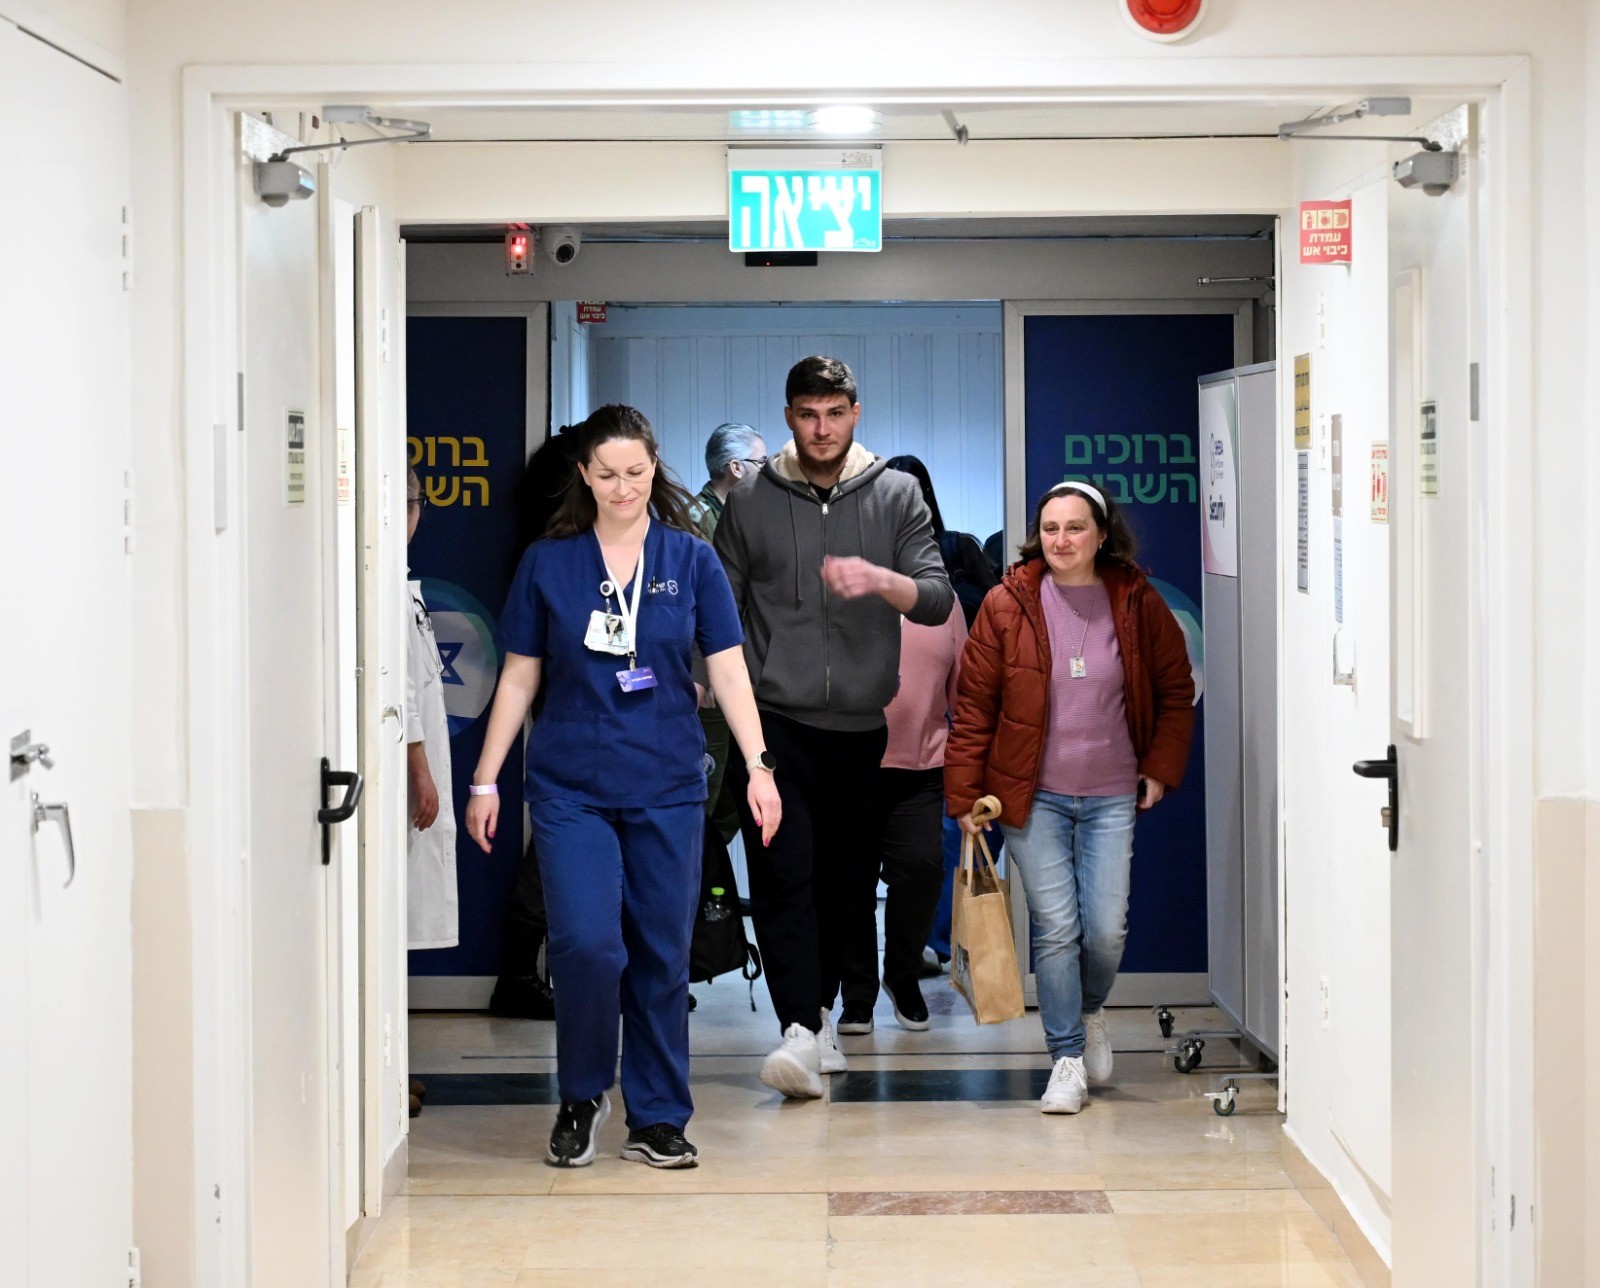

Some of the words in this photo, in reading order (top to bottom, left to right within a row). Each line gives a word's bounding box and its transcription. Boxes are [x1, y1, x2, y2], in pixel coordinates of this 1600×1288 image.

[741, 175, 871, 248] יציאה
[1309, 233, 1341, 243] עמדת
[1303, 246, 1321, 256] אש
[1323, 244, 1348, 255] כיבוי
[1065, 434, 1196, 465] ברוכים
[1063, 473, 1197, 504] השבי
